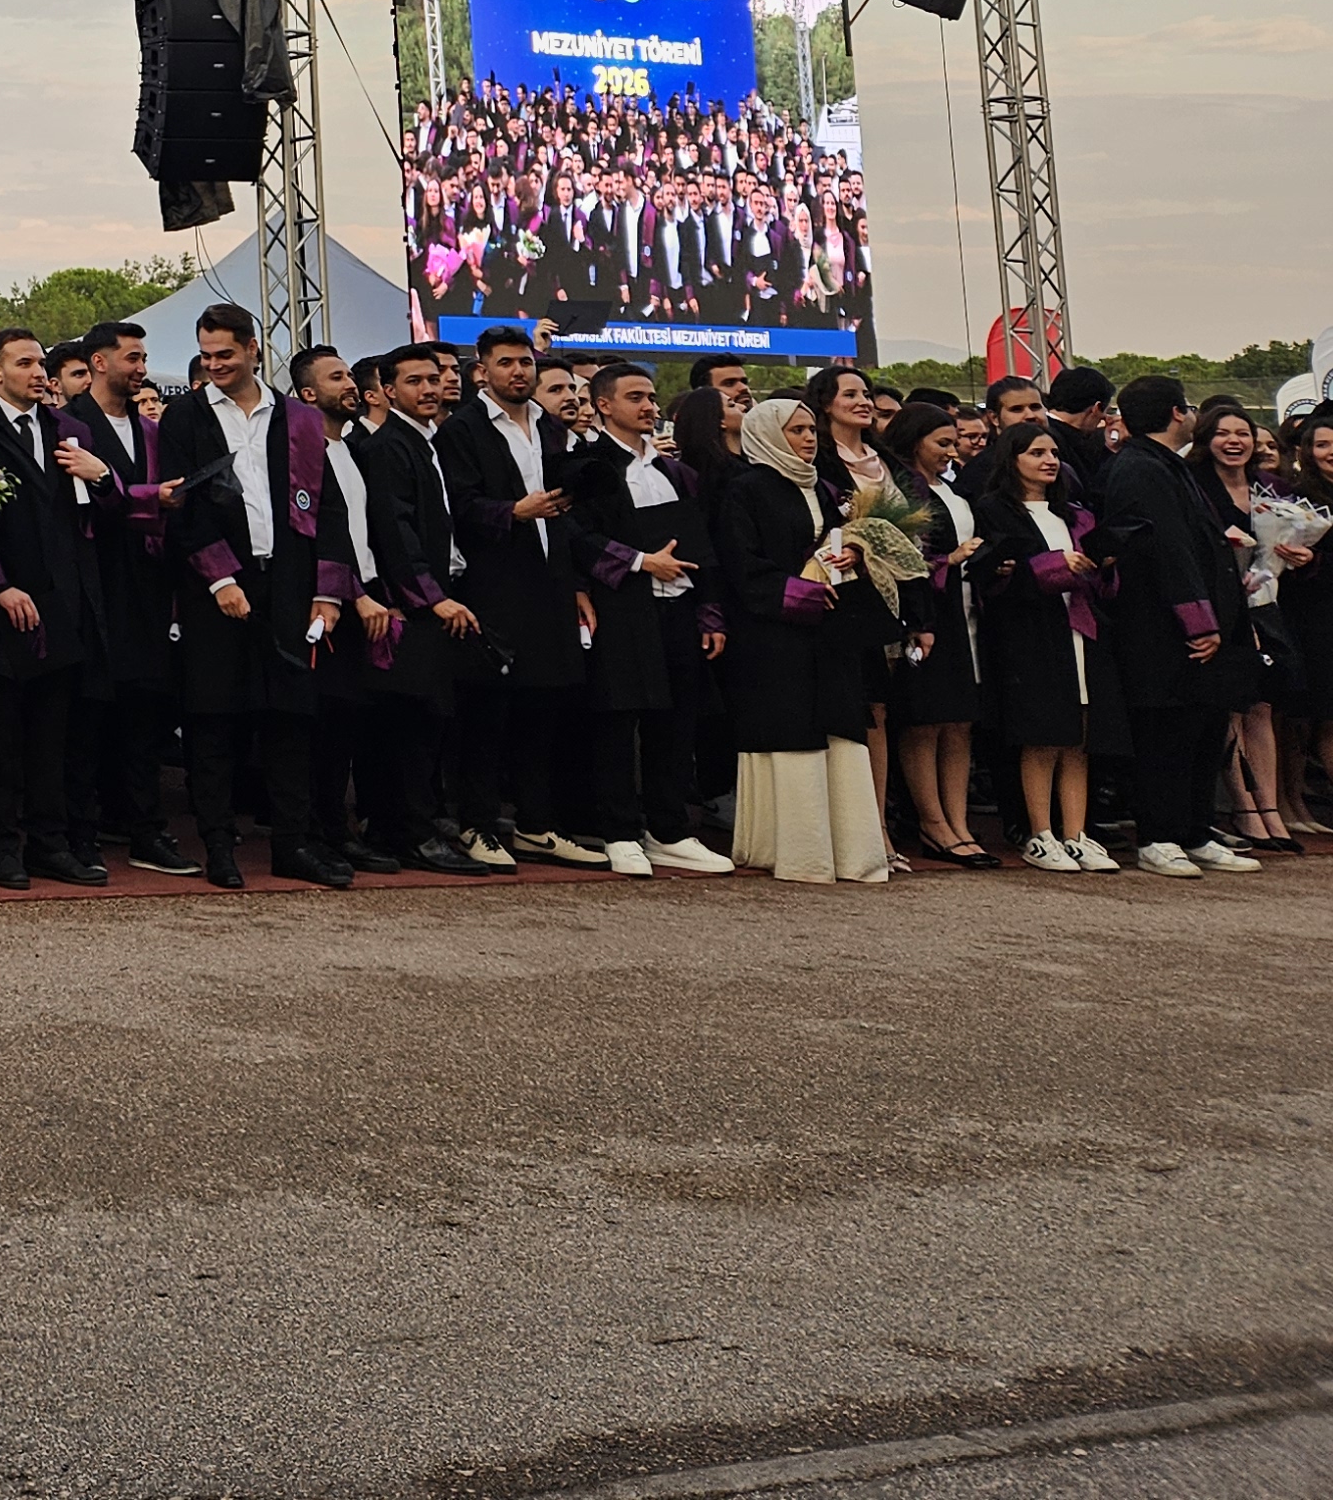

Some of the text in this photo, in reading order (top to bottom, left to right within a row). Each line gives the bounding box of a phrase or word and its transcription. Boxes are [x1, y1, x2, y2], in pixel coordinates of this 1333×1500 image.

[531, 28, 703, 66] MEZUNİYET TÖRENİ
[592, 64, 651, 98] 2026
